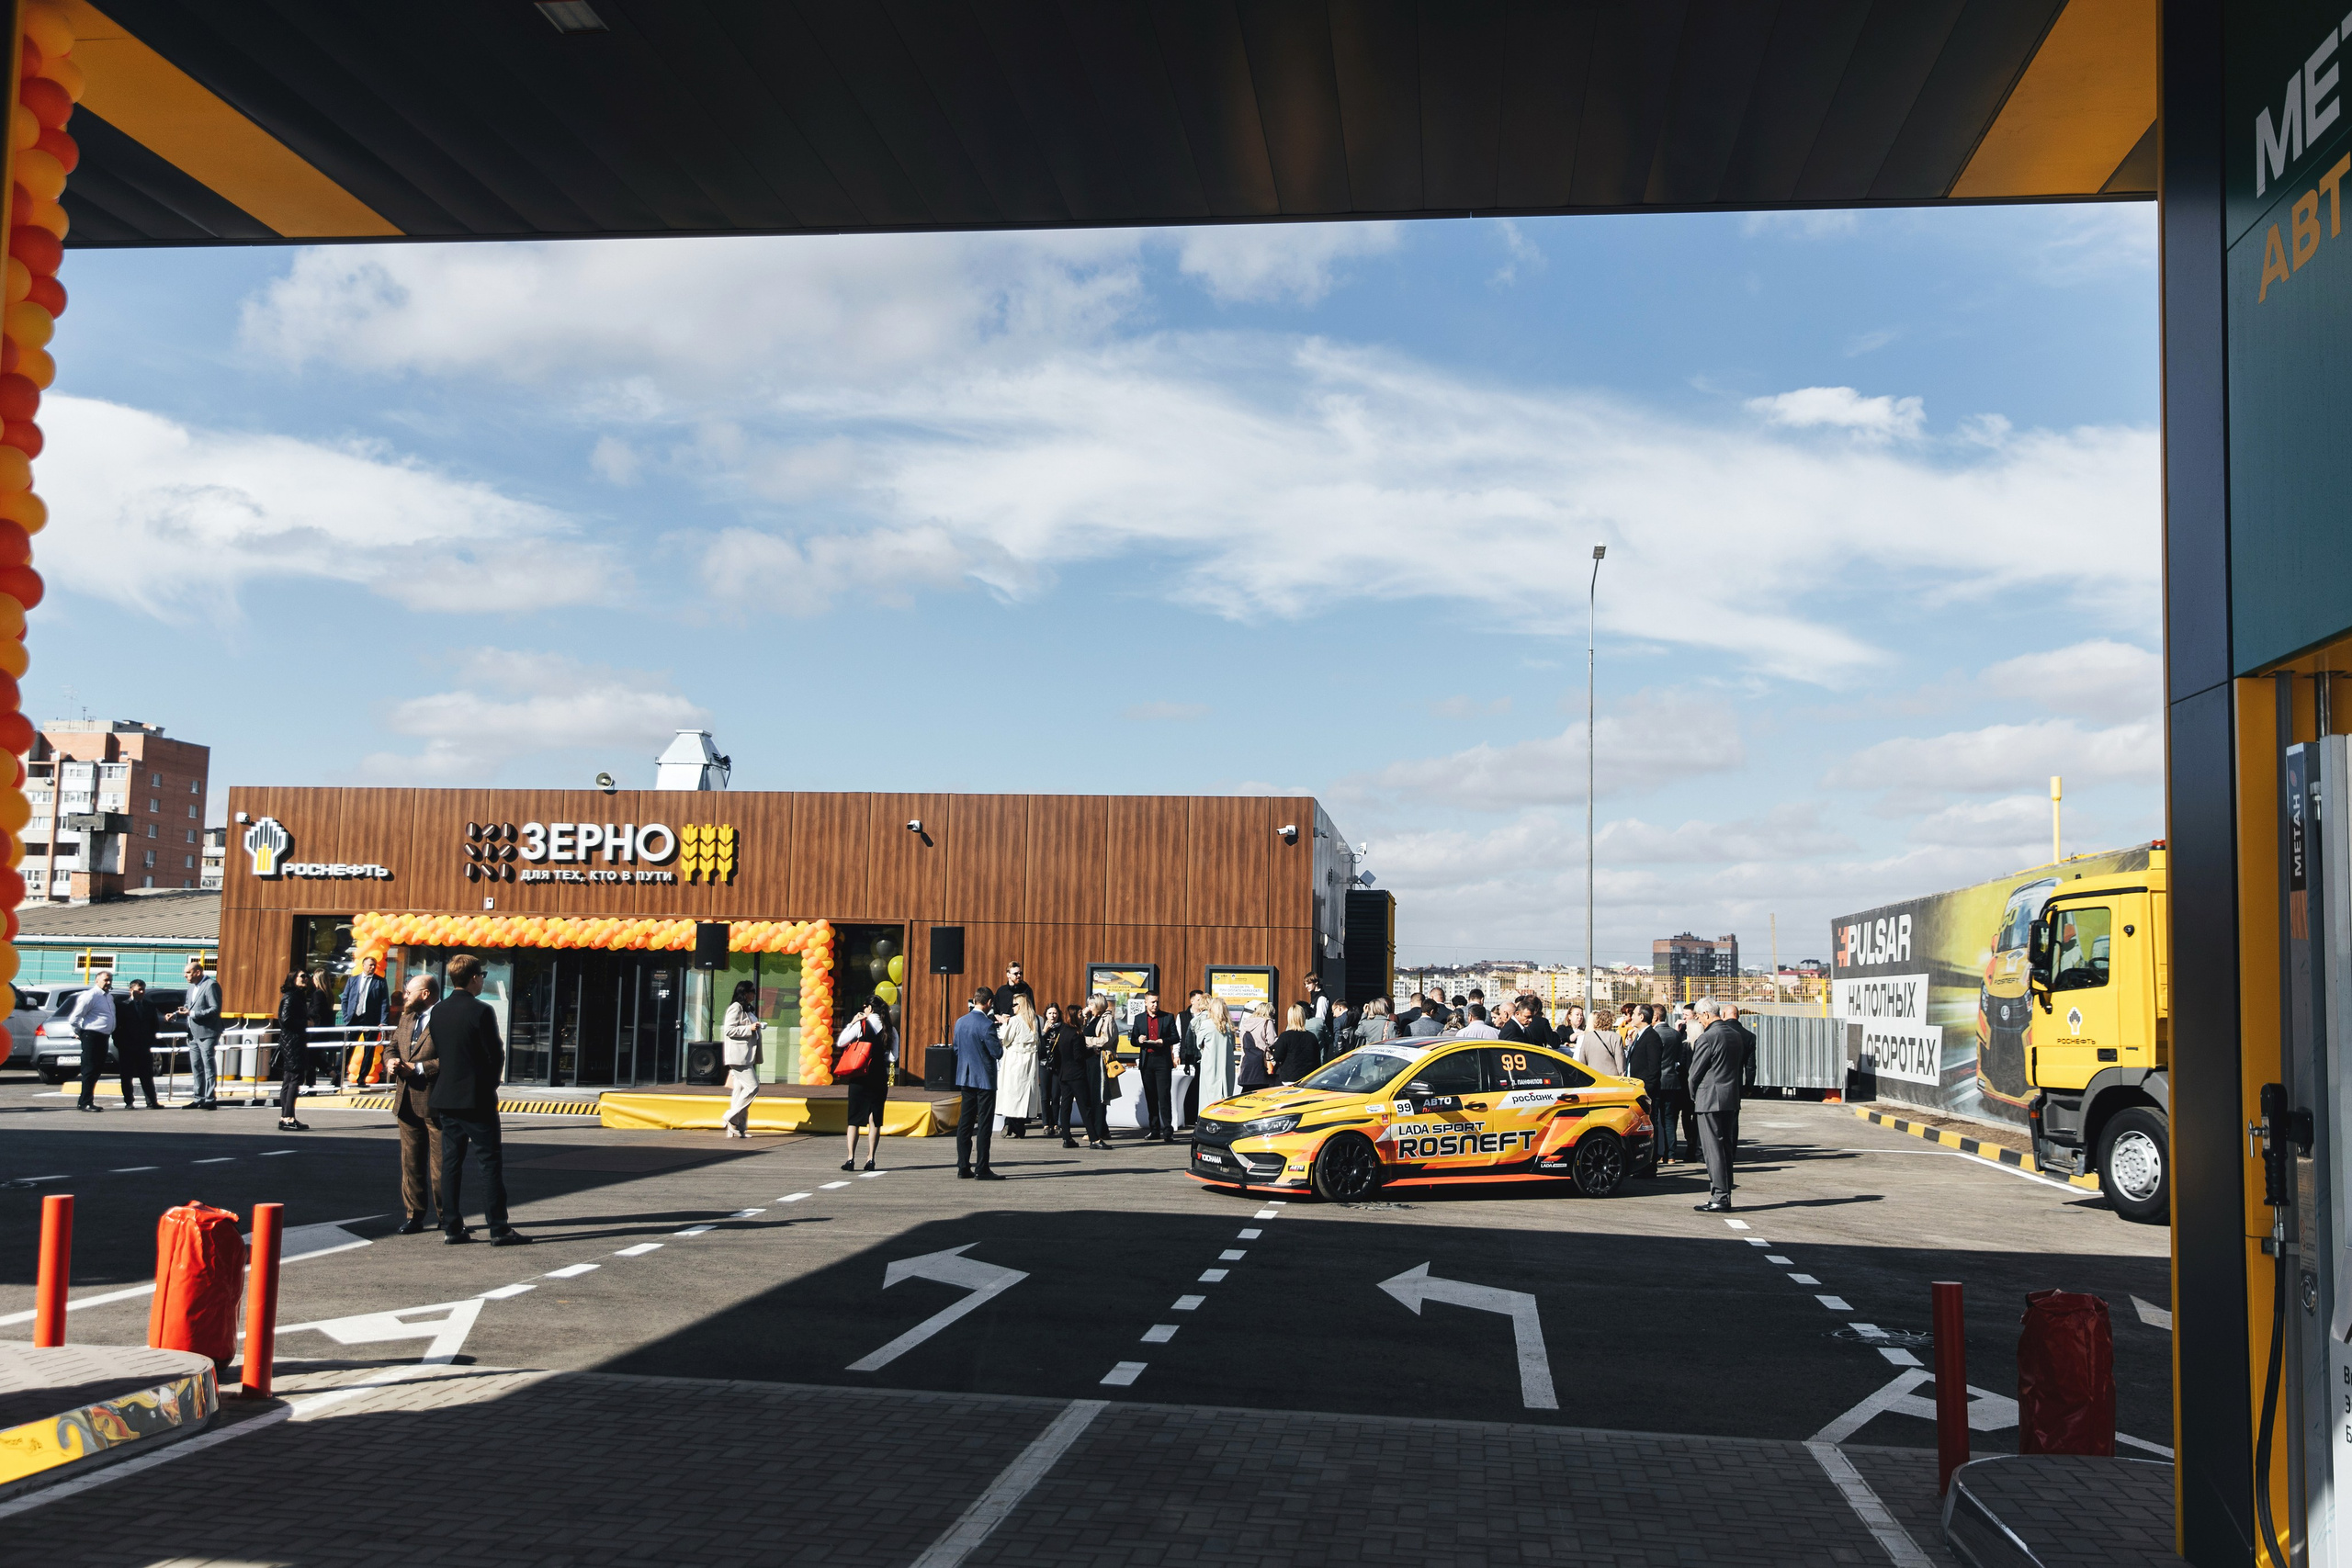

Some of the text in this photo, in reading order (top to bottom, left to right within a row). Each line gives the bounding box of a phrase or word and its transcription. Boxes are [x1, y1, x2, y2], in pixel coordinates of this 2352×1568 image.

[2256, 9, 2352, 199] МЕ
[520, 821, 675, 863] ЗЕРНО
[2292, 794, 2302, 877] МЕТАН
[281, 863, 390, 877] РОСНЕФТЬ
[520, 869, 673, 882] ДЛЯ ТЕХ, КТО В ПУТИ
[1847, 913, 1912, 967] PULSAR
[1848, 981, 1917, 1018] НА ПОЛНЫХ
[1500, 1054, 1527, 1071] 99
[1866, 1033, 1937, 1077] ОБОРОТАХ
[1396, 1102, 1412, 1113] 99
[1423, 1097, 1452, 1107] АВТО
[1511, 1091, 1555, 1104] росбанк
[1398, 1122, 1486, 1136] LADA SPORT
[1397, 1129, 1537, 1160] ROSNEFT
[2343, 1365, 2352, 1385] В
